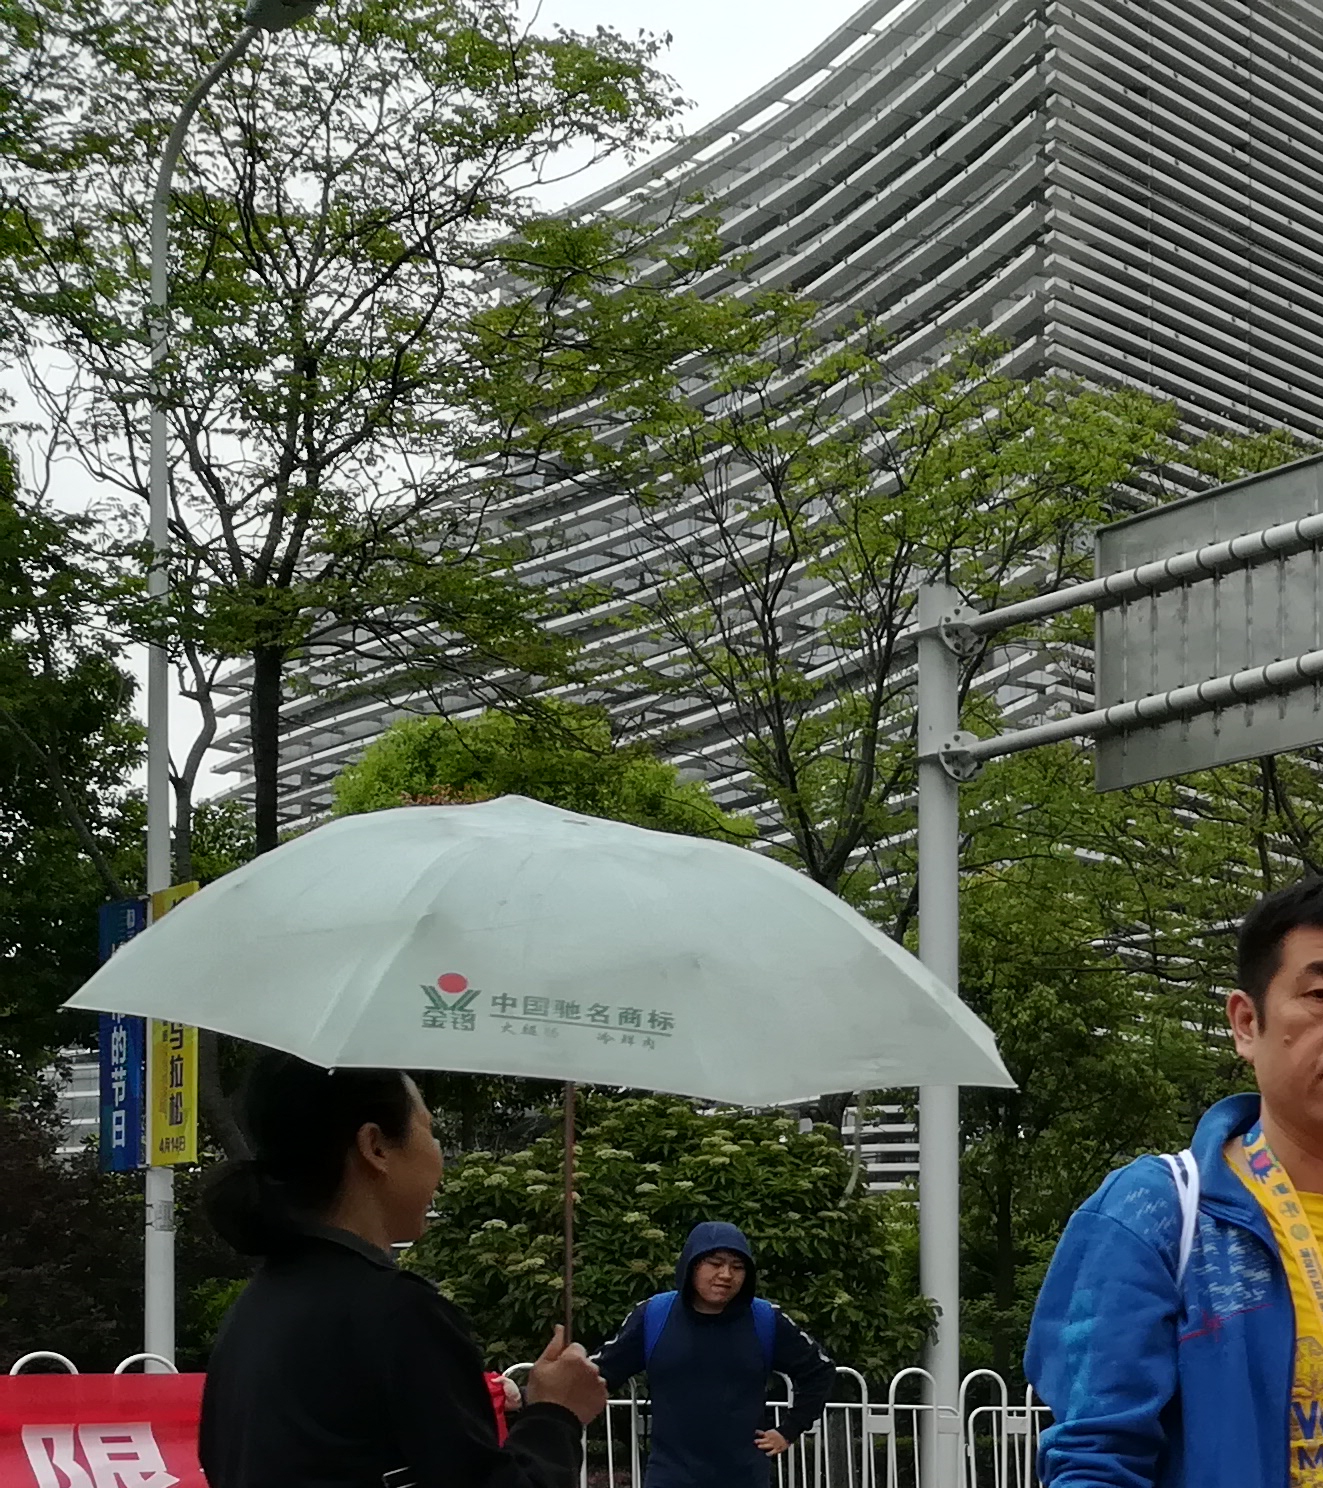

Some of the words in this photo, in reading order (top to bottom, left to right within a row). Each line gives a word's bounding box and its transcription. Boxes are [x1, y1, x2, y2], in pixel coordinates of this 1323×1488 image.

[491, 992, 675, 1031] 中国驰名商标
